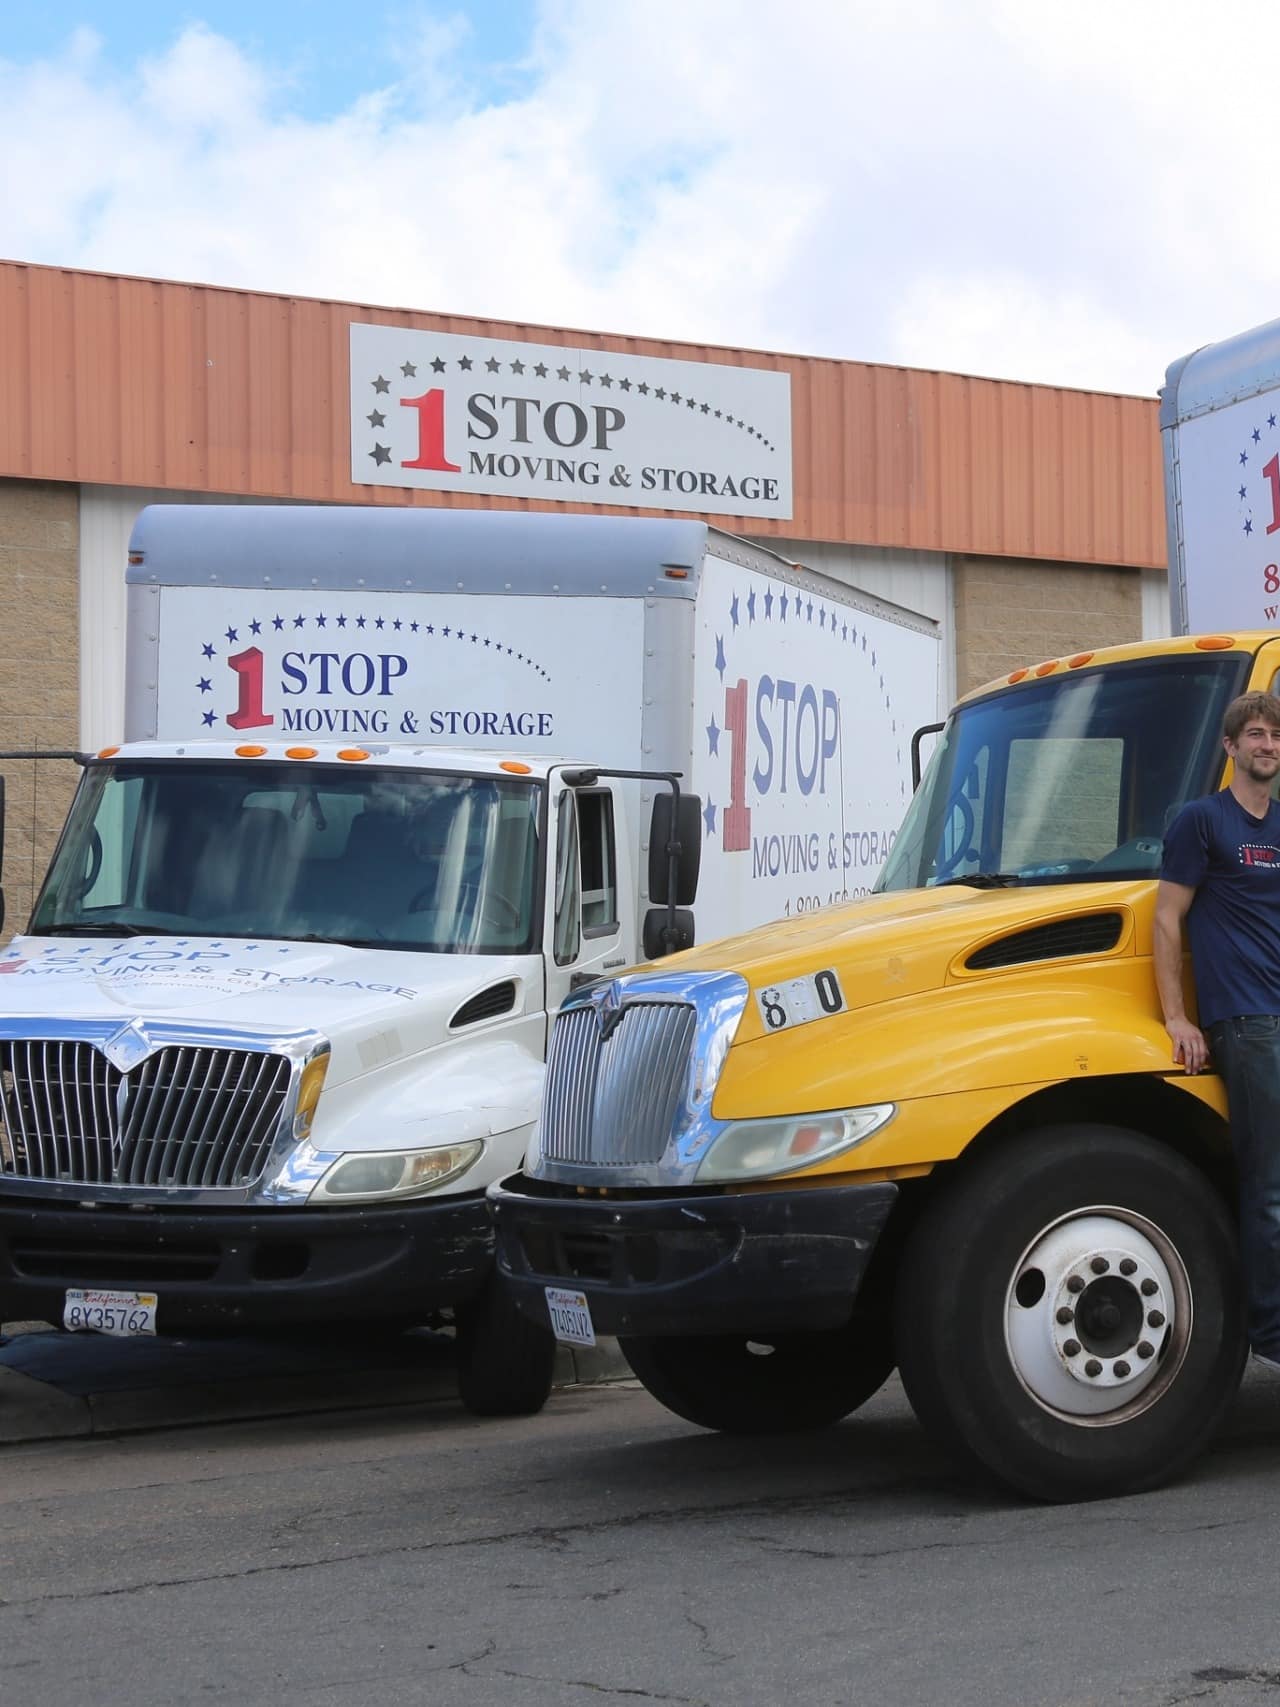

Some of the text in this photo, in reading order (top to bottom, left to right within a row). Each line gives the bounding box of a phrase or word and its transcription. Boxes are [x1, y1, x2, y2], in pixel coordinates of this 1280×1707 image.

[400, 388, 626, 473] 1 STOP
[468, 451, 779, 501] MOVING & STORAGE
[226, 646, 408, 730] 1 STOP
[281, 708, 554, 736] MOVING & STORAGE
[723, 674, 839, 852] 1 STOP
[753, 830, 899, 878] MOVING & STORA
[20, 964, 177, 975] MOVING
[231, 967, 419, 1000] STORAGE
[40, 950, 230, 966] STOP
[70, 1307, 150, 1331] 8Y35762
